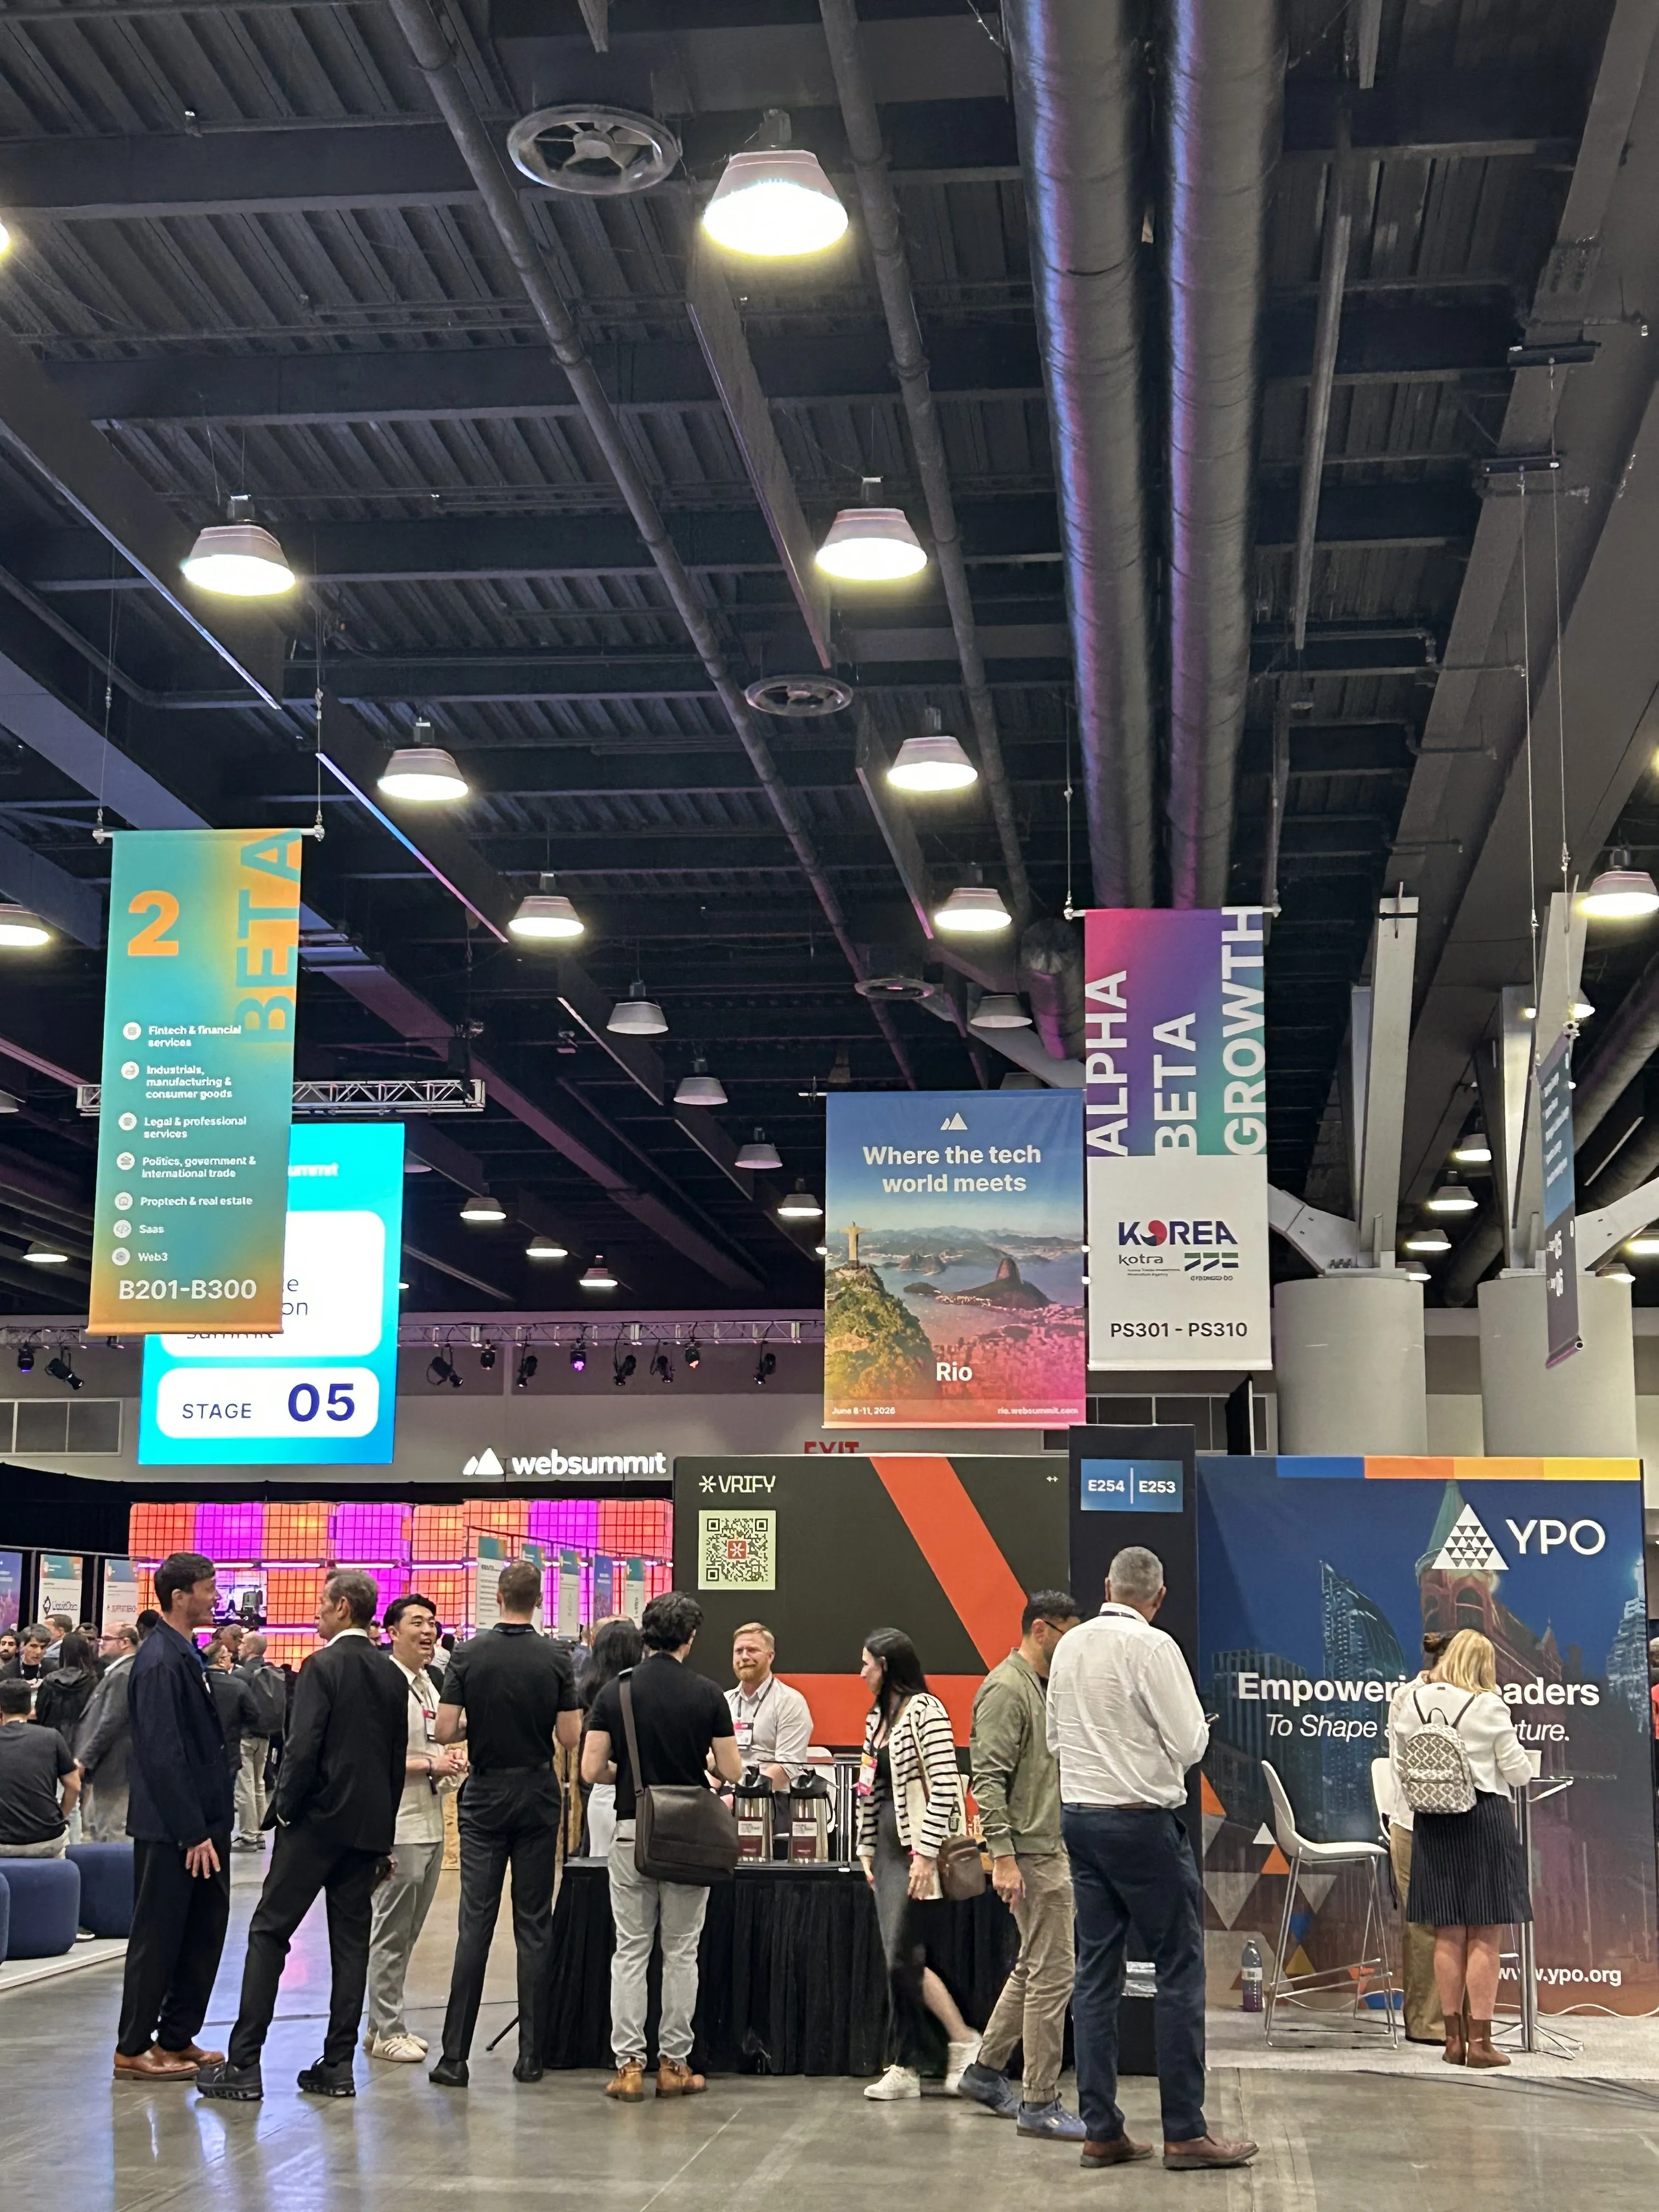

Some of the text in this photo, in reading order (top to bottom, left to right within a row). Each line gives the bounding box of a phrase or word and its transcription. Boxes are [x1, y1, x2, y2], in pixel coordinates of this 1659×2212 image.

[128, 890, 179, 956] 2
[234, 829, 302, 1042] BETA
[149, 1025, 241, 1035] Fintech & financial
[1222, 906, 1267, 1155] GROWTH
[148, 1037, 191, 1047] services
[146, 1065, 205, 1075] Industrials,
[1085, 970, 1128, 1156] ALPHA
[146, 1077, 232, 1087] manufacturing &
[1153, 1012, 1197, 1155] BETA
[200, 1090, 233, 1101] goods
[144, 1116, 246, 1127] Legal & professional
[144, 1130, 188, 1138] services
[142, 1156, 256, 1167] Politics, government &
[862, 1144, 1041, 1165] Where the tech
[208, 1169, 236, 1177] trade
[882, 1173, 1027, 1193] world meets
[140, 1197, 253, 1207] Proptech & real estate
[1119, 1220, 1238, 1246] KOREA
[138, 1252, 168, 1262] Web3
[1119, 1254, 1163, 1266] kotra
[119, 1279, 257, 1300] B201-B300
[1111, 1323, 1168, 1337] PS301
[1189, 1322, 1248, 1337] PS310
[936, 1362, 973, 1381] Rio
[182, 1383, 355, 1422] STAGE 05
[512, 1449, 667, 1475] websummit
[718, 1475, 776, 1493] VRIFY
[1088, 1479, 1176, 1493] E254 E253
[1506, 1519, 1606, 1555] YPO
[1238, 1672, 1599, 1707] Empower aders
[1266, 1714, 1293, 1736] To
[1300, 1714, 1378, 1742] Shape
[1515, 1719, 1570, 1741] ture.
